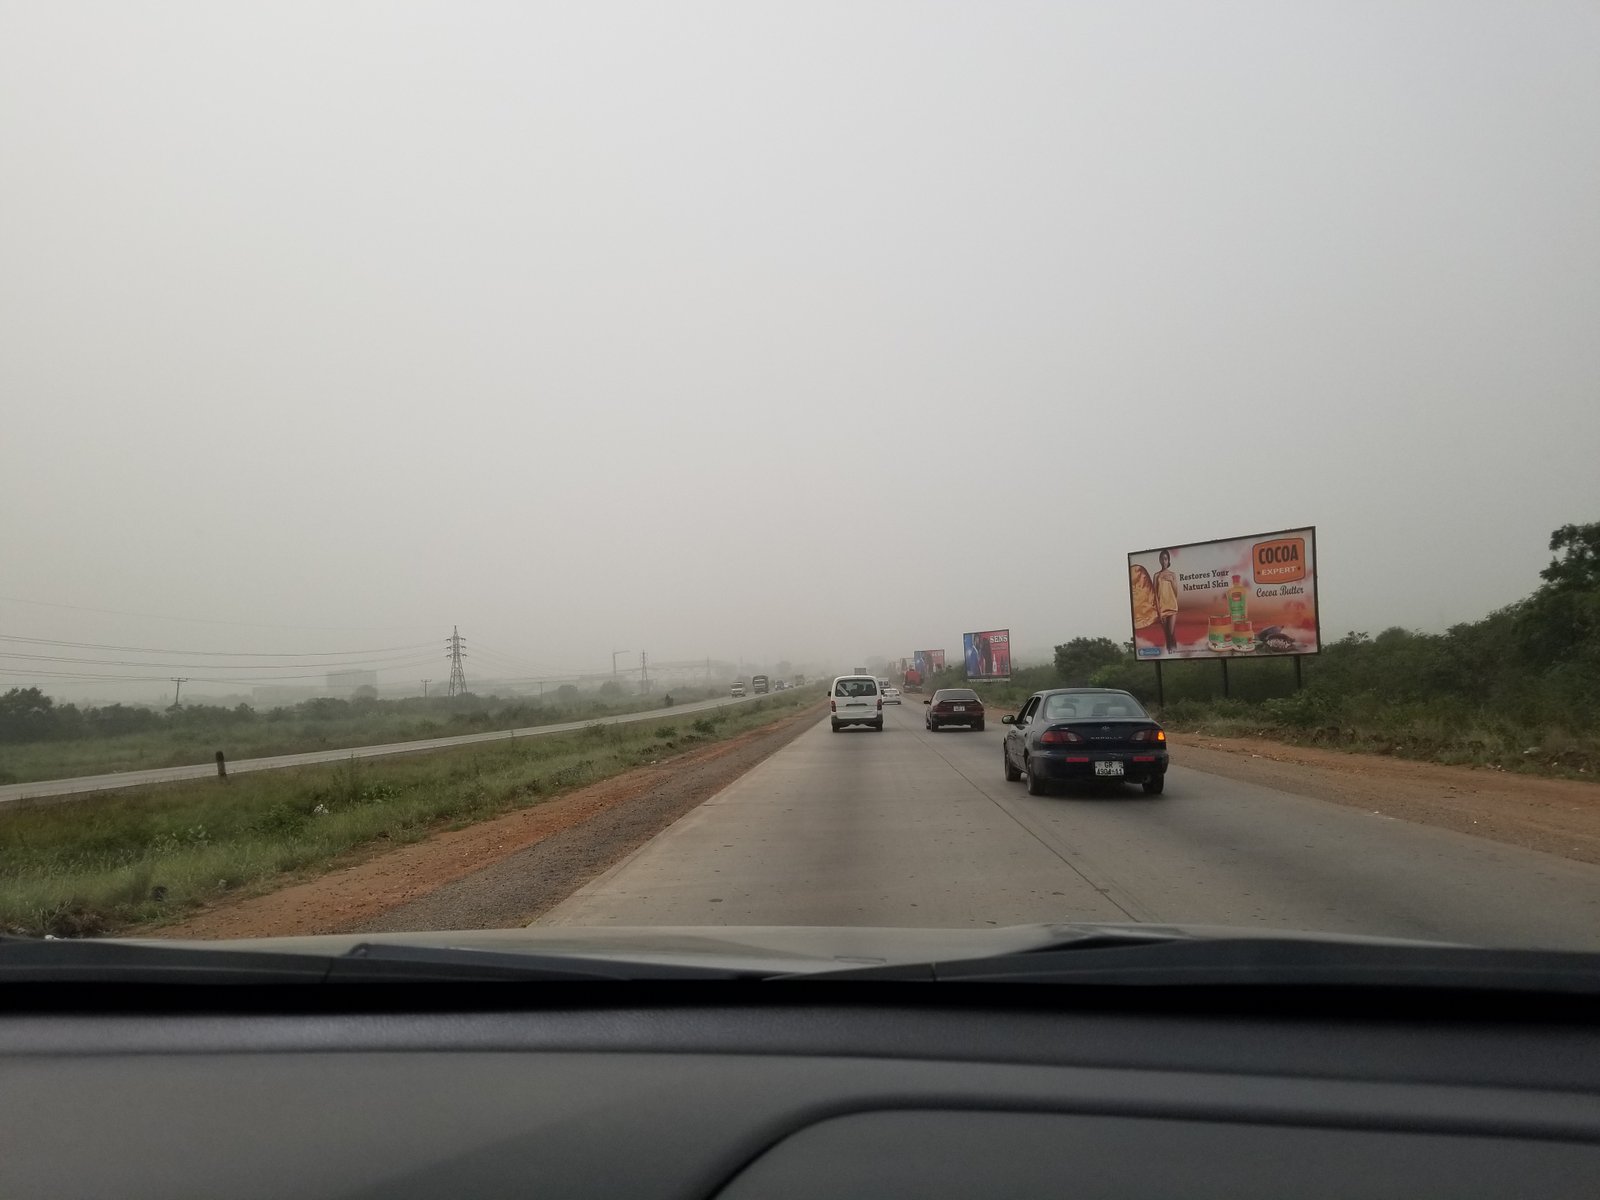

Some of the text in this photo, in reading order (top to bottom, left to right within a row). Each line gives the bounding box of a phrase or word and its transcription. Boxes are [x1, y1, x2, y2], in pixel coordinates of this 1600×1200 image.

[1258, 544, 1299, 565] COCOA
[1179, 569, 1229, 582] Restores Your
[1261, 566, 1297, 576] EXPERT
[1183, 580, 1229, 591] Natural Skin
[1256, 585, 1304, 598] Cocoa Butter
[989, 634, 1008, 644] SENS
[1104, 761, 1113, 769] GR
